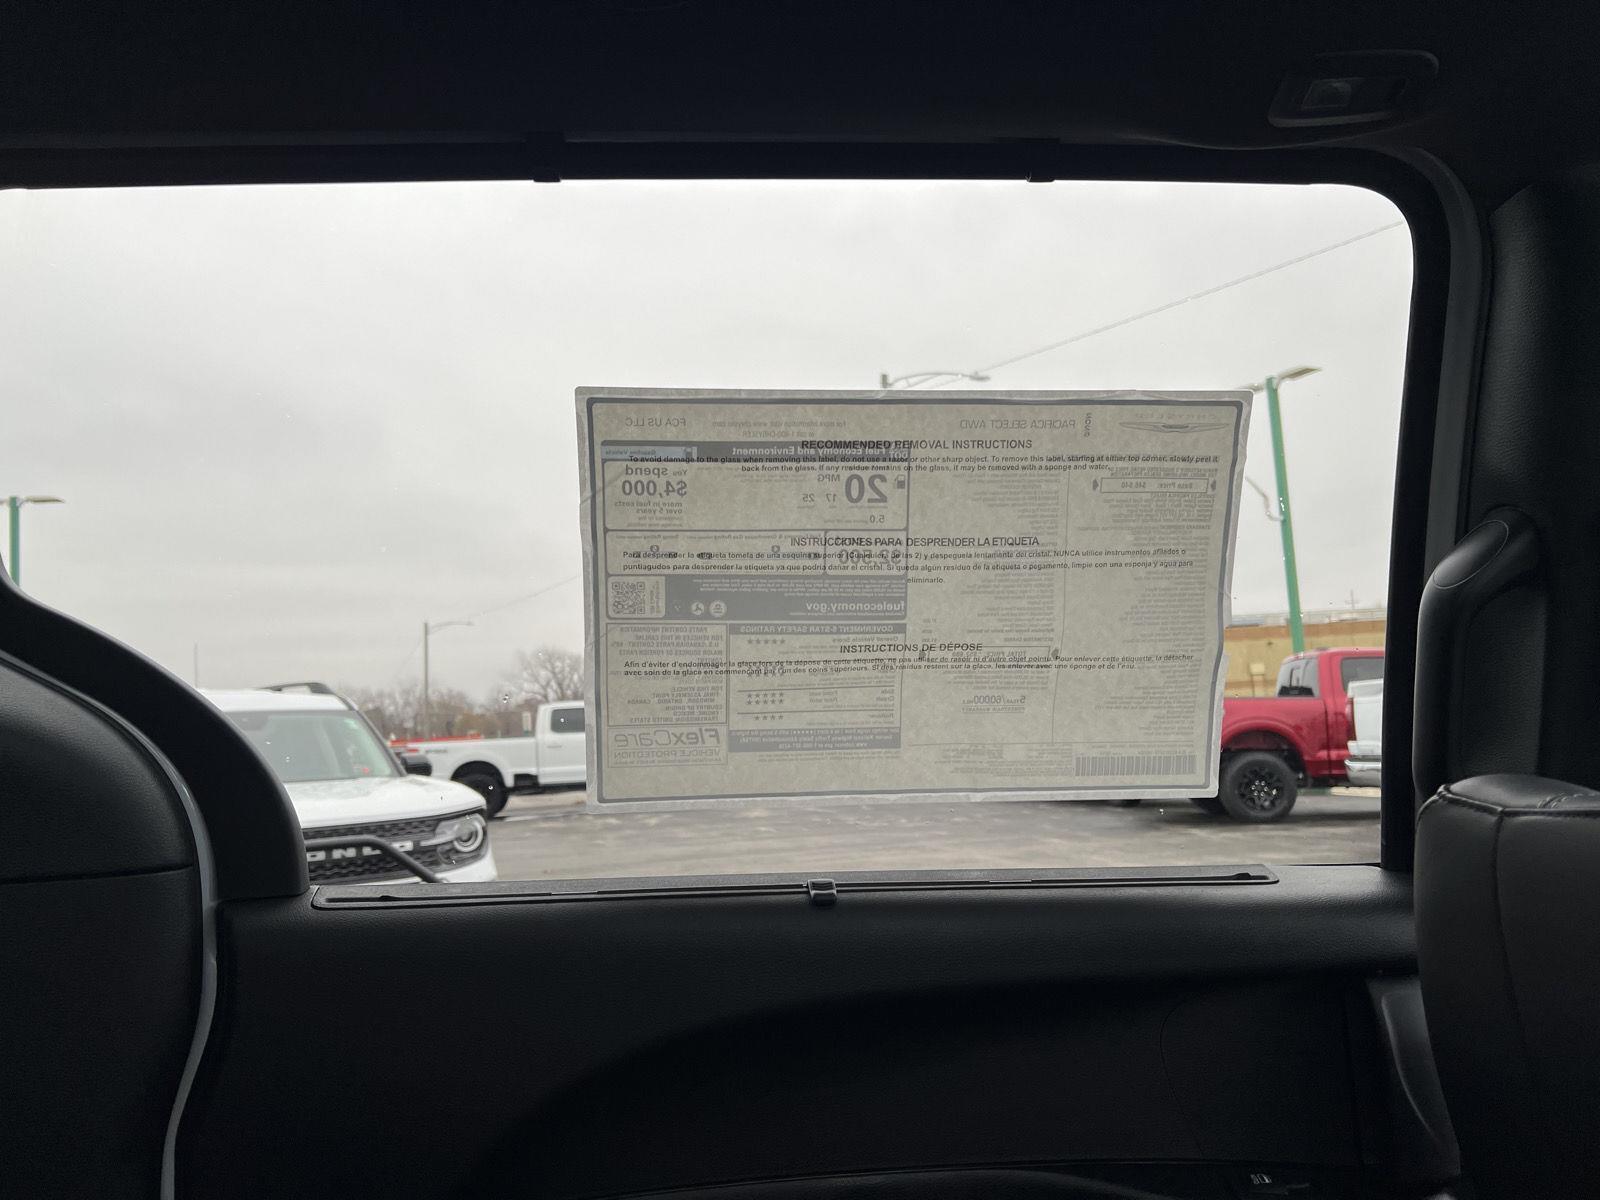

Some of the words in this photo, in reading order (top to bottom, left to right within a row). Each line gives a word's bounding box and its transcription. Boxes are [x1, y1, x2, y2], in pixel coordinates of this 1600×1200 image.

[801, 440, 890, 450] RECOMMENDED
[894, 439, 949, 450] REMOVAL
[952, 439, 1032, 450] INSTRUCTIONS
[639, 455, 662, 463] avoid
[662, 455, 695, 465] damage
[703, 455, 719, 463] the
[720, 455, 741, 465] glass
[742, 455, 763, 463] when
[764, 455, 801, 465] removing
[802, 455, 817, 463] this
[851, 455, 865, 463] not
[920, 455, 938, 463] other
[939, 455, 963, 465] sharp
[1030, 455, 1044, 463] this
[1067, 455, 1095, 465] starting
[1105, 455, 1126, 463] either
[1127, 455, 1140, 465] top
[1169, 455, 1194, 465] slowly
[741, 464, 760, 472] back
[761, 464, 780, 472] from
[781, 464, 794, 472] the
[825, 465, 840, 473] any
[960, 465, 975, 473] may
[988, 463, 1019, 471] removed
[1020, 463, 1036, 471] with
[1044, 464, 1072, 473] sponge
[791, 538, 872, 547] INSTRUCCIONES
[874, 537, 902, 546] PARA
[907, 537, 976, 546] DESPRENDER
[977, 537, 990, 546] LA
[992, 537, 1040, 546] ETIQUETA
[623, 551, 641, 559] Para
[642, 551, 685, 561] desprender
[782, 551, 812, 561] esquina
[623, 563, 671, 572] puntiagudos
[672, 564, 690, 572] para
[691, 563, 734, 572] desprender
[744, 563, 774, 572] etiqueta
[991, 563, 1021, 572] etiqueta
[1124, 561, 1152, 569] esponja
[1177, 561, 1194, 569] para
[840, 644, 919, 654] INSTRUCTIONS
[922, 644, 936, 652] DE
[939, 641, 983, 652] DÉPOSE
[898, 658, 912, 666] pas
[1008, 656, 1027, 664] objet
[643, 668, 661, 676] soin
[682, 668, 702, 678] glace
